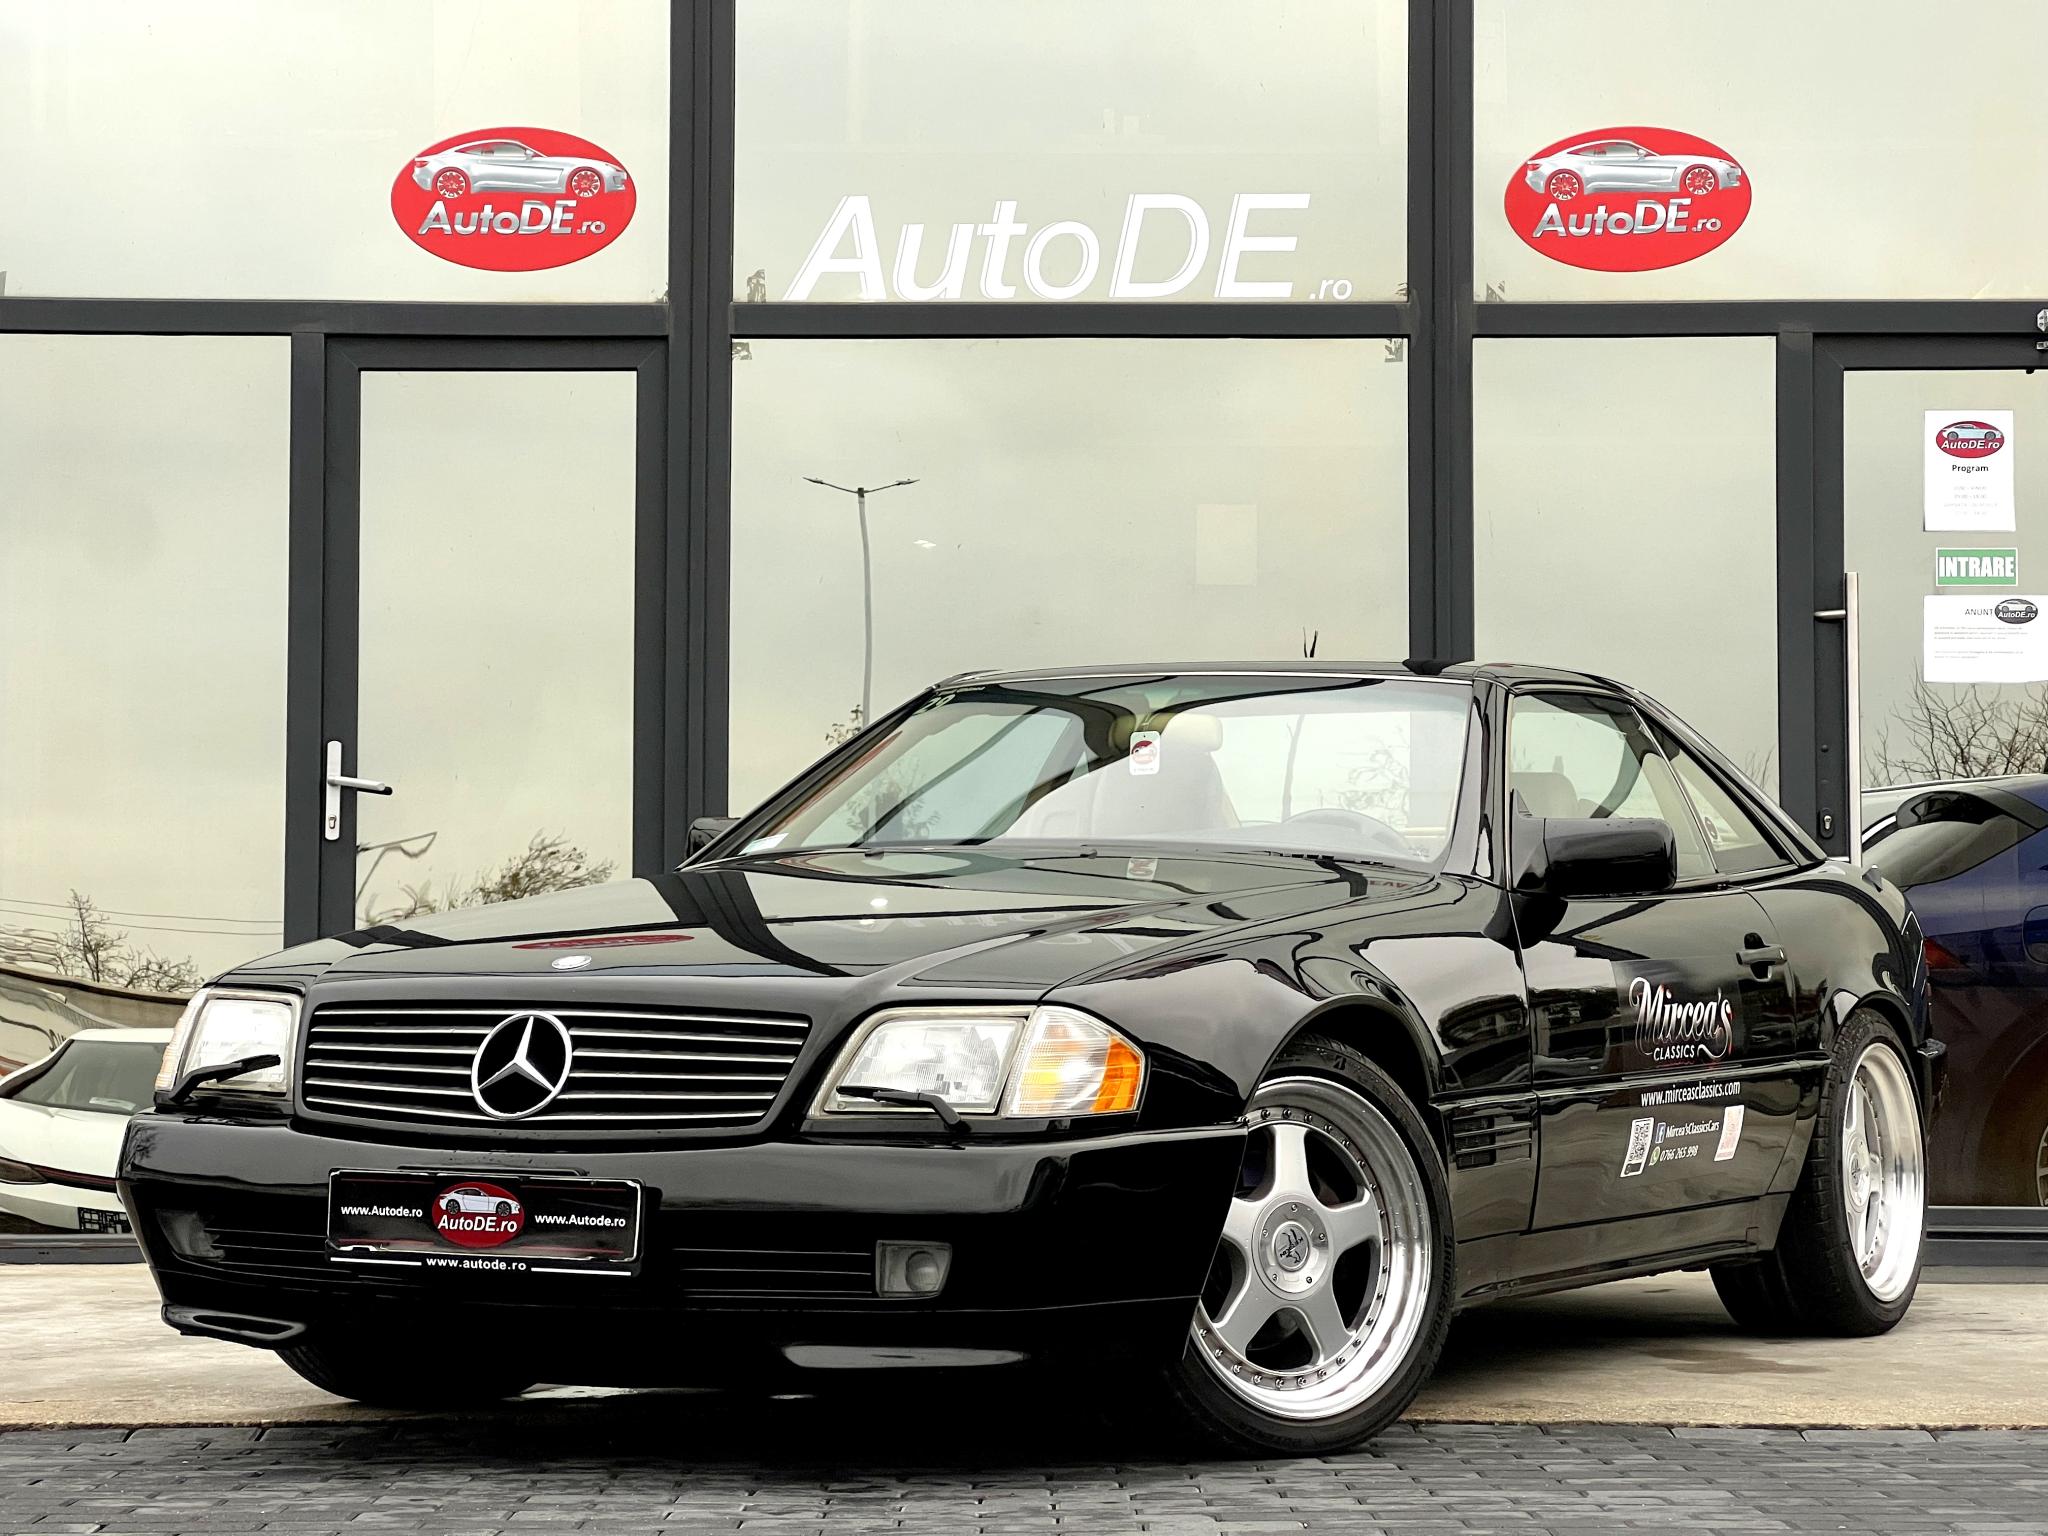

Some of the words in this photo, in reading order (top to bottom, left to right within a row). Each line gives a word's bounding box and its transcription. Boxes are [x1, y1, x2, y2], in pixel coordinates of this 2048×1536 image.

[417, 199, 607, 235] AutoDE.ro
[1531, 197, 1723, 238] AutoDE.ro
[1941, 440, 2000, 449] AutoDE.ro
[1952, 464, 1989, 474] Program
[1938, 556, 2015, 578] INTRARE
[1628, 976, 1733, 1060] Mircea's
[1653, 1044, 1695, 1061] CLASSICS
[1640, 1080, 1741, 1107] www.mirceasclassics.com
[340, 1204, 423, 1218] www.Autode.ro
[437, 1214, 518, 1233] AutoDE.ro
[534, 1213, 626, 1228] www.Autode.ro
[426, 1256, 527, 1271] www.autode.ro
